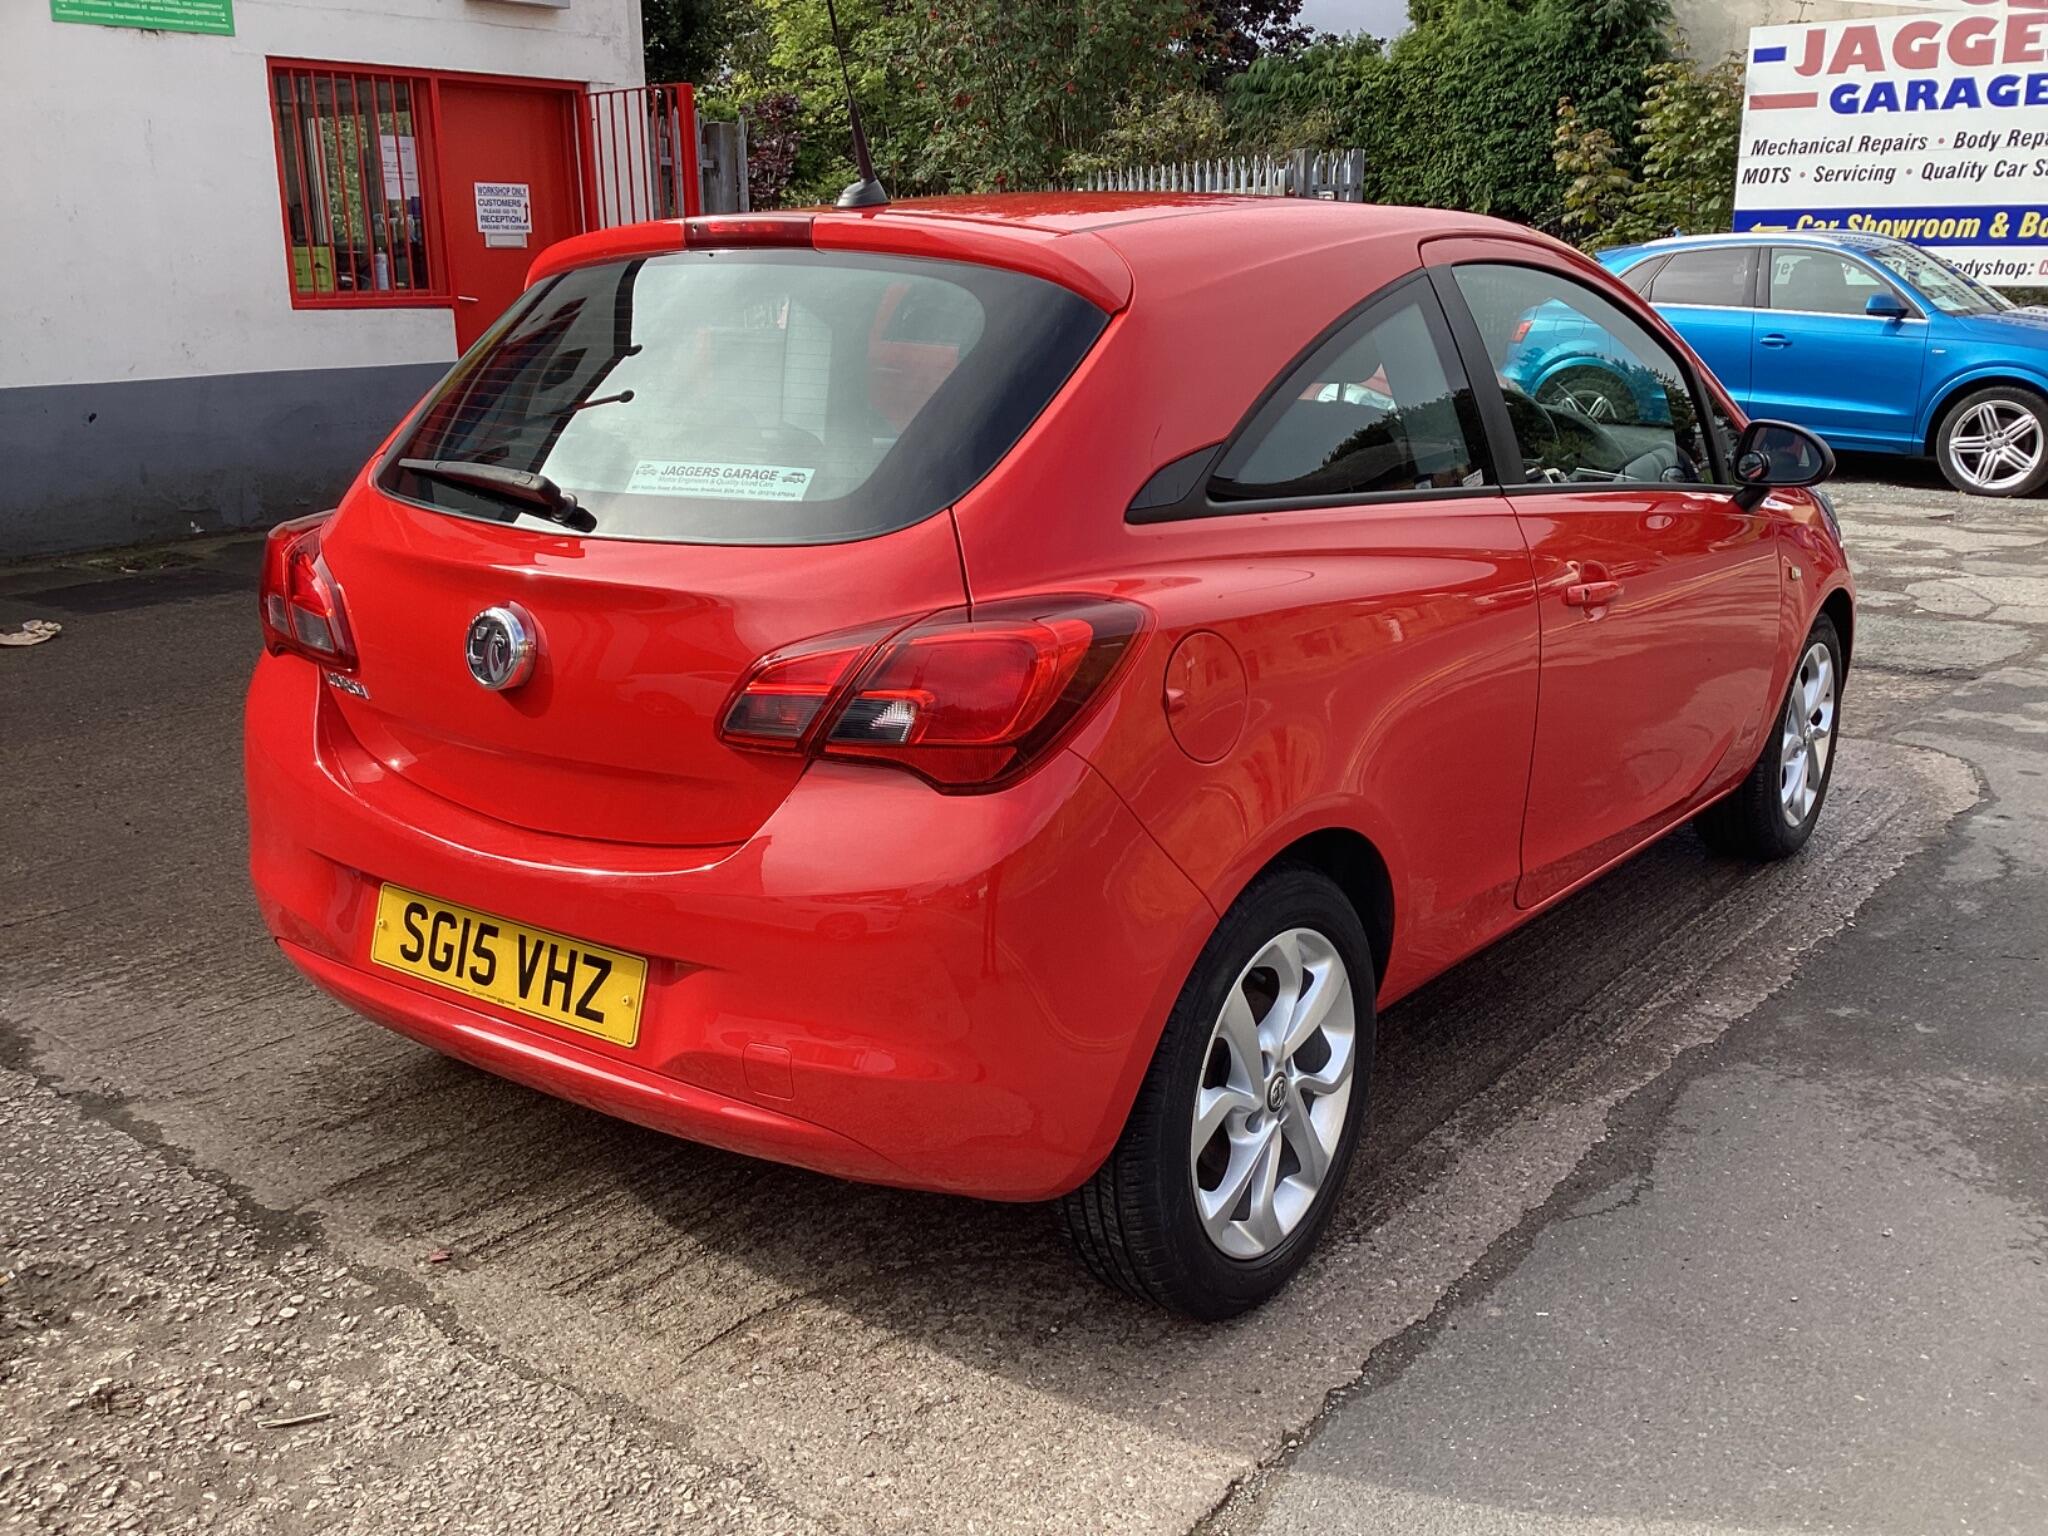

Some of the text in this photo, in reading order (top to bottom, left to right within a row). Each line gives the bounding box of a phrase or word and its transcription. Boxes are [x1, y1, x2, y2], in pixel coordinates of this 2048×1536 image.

[1794, 12, 2048, 77] JAGGE
[1829, 73, 2048, 115] GARAGE
[1750, 136, 1854, 157] Mechanical
[1858, 133, 1929, 156] Repairs
[1953, 130, 2002, 152] Body
[1742, 166, 1792, 185] MOTS
[1813, 164, 1897, 185] Servicing
[1921, 161, 1989, 183] Quality
[1994, 159, 2029, 178] Car
[477, 186, 527, 196] WORKSHOP ONLY
[477, 199, 522, 208] CUSTOMERS
[480, 215, 522, 223] RECEPTION
[1847, 213, 1981, 239] Showroom
[1989, 211, 2010, 238] &
[1946, 258, 2035, 280] odyshop:
[661, 465, 780, 481] JAGGERS GARAGE
[399, 901, 612, 1025] SG15 VHZ
